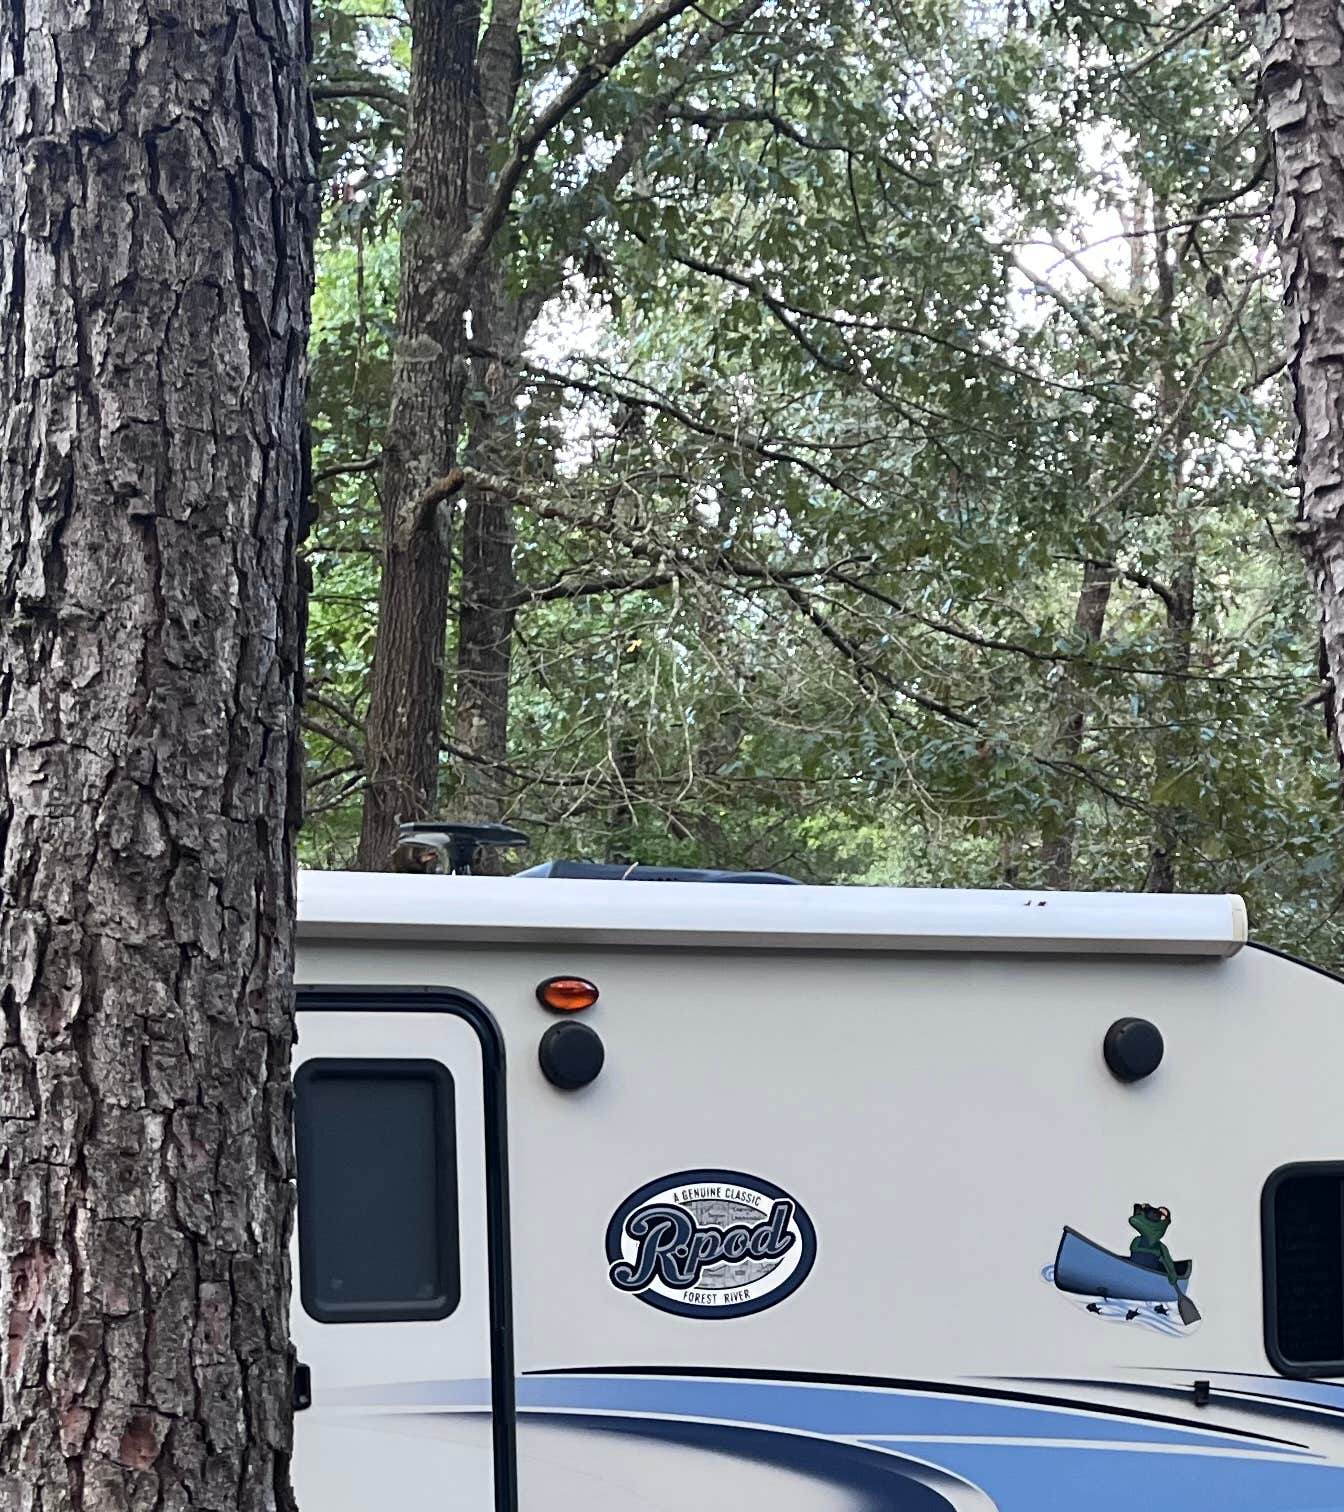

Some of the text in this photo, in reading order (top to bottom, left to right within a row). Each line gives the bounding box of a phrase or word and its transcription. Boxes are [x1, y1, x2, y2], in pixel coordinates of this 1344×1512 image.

[673, 1187, 761, 1206] A GENUINE CLASSIC
[683, 1289, 751, 1304] FOREST RIVER
